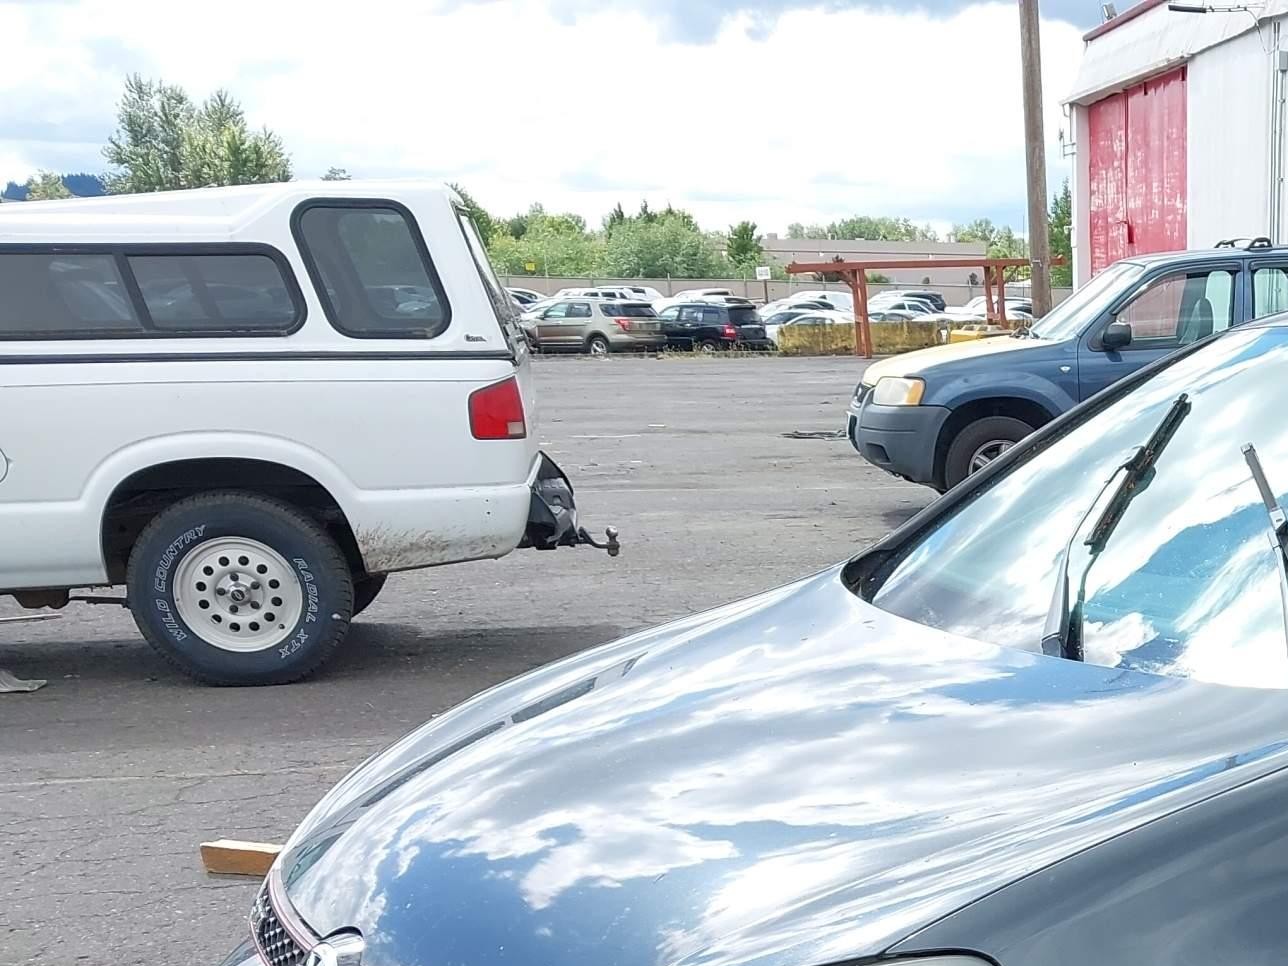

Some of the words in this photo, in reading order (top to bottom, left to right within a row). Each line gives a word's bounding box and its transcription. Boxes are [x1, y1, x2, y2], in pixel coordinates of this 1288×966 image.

[154, 524, 206, 593] COUNTRY
[293, 557, 319, 623] RADIAL
[156, 599, 188, 642] WILD
[279, 628, 309, 660] XTX
